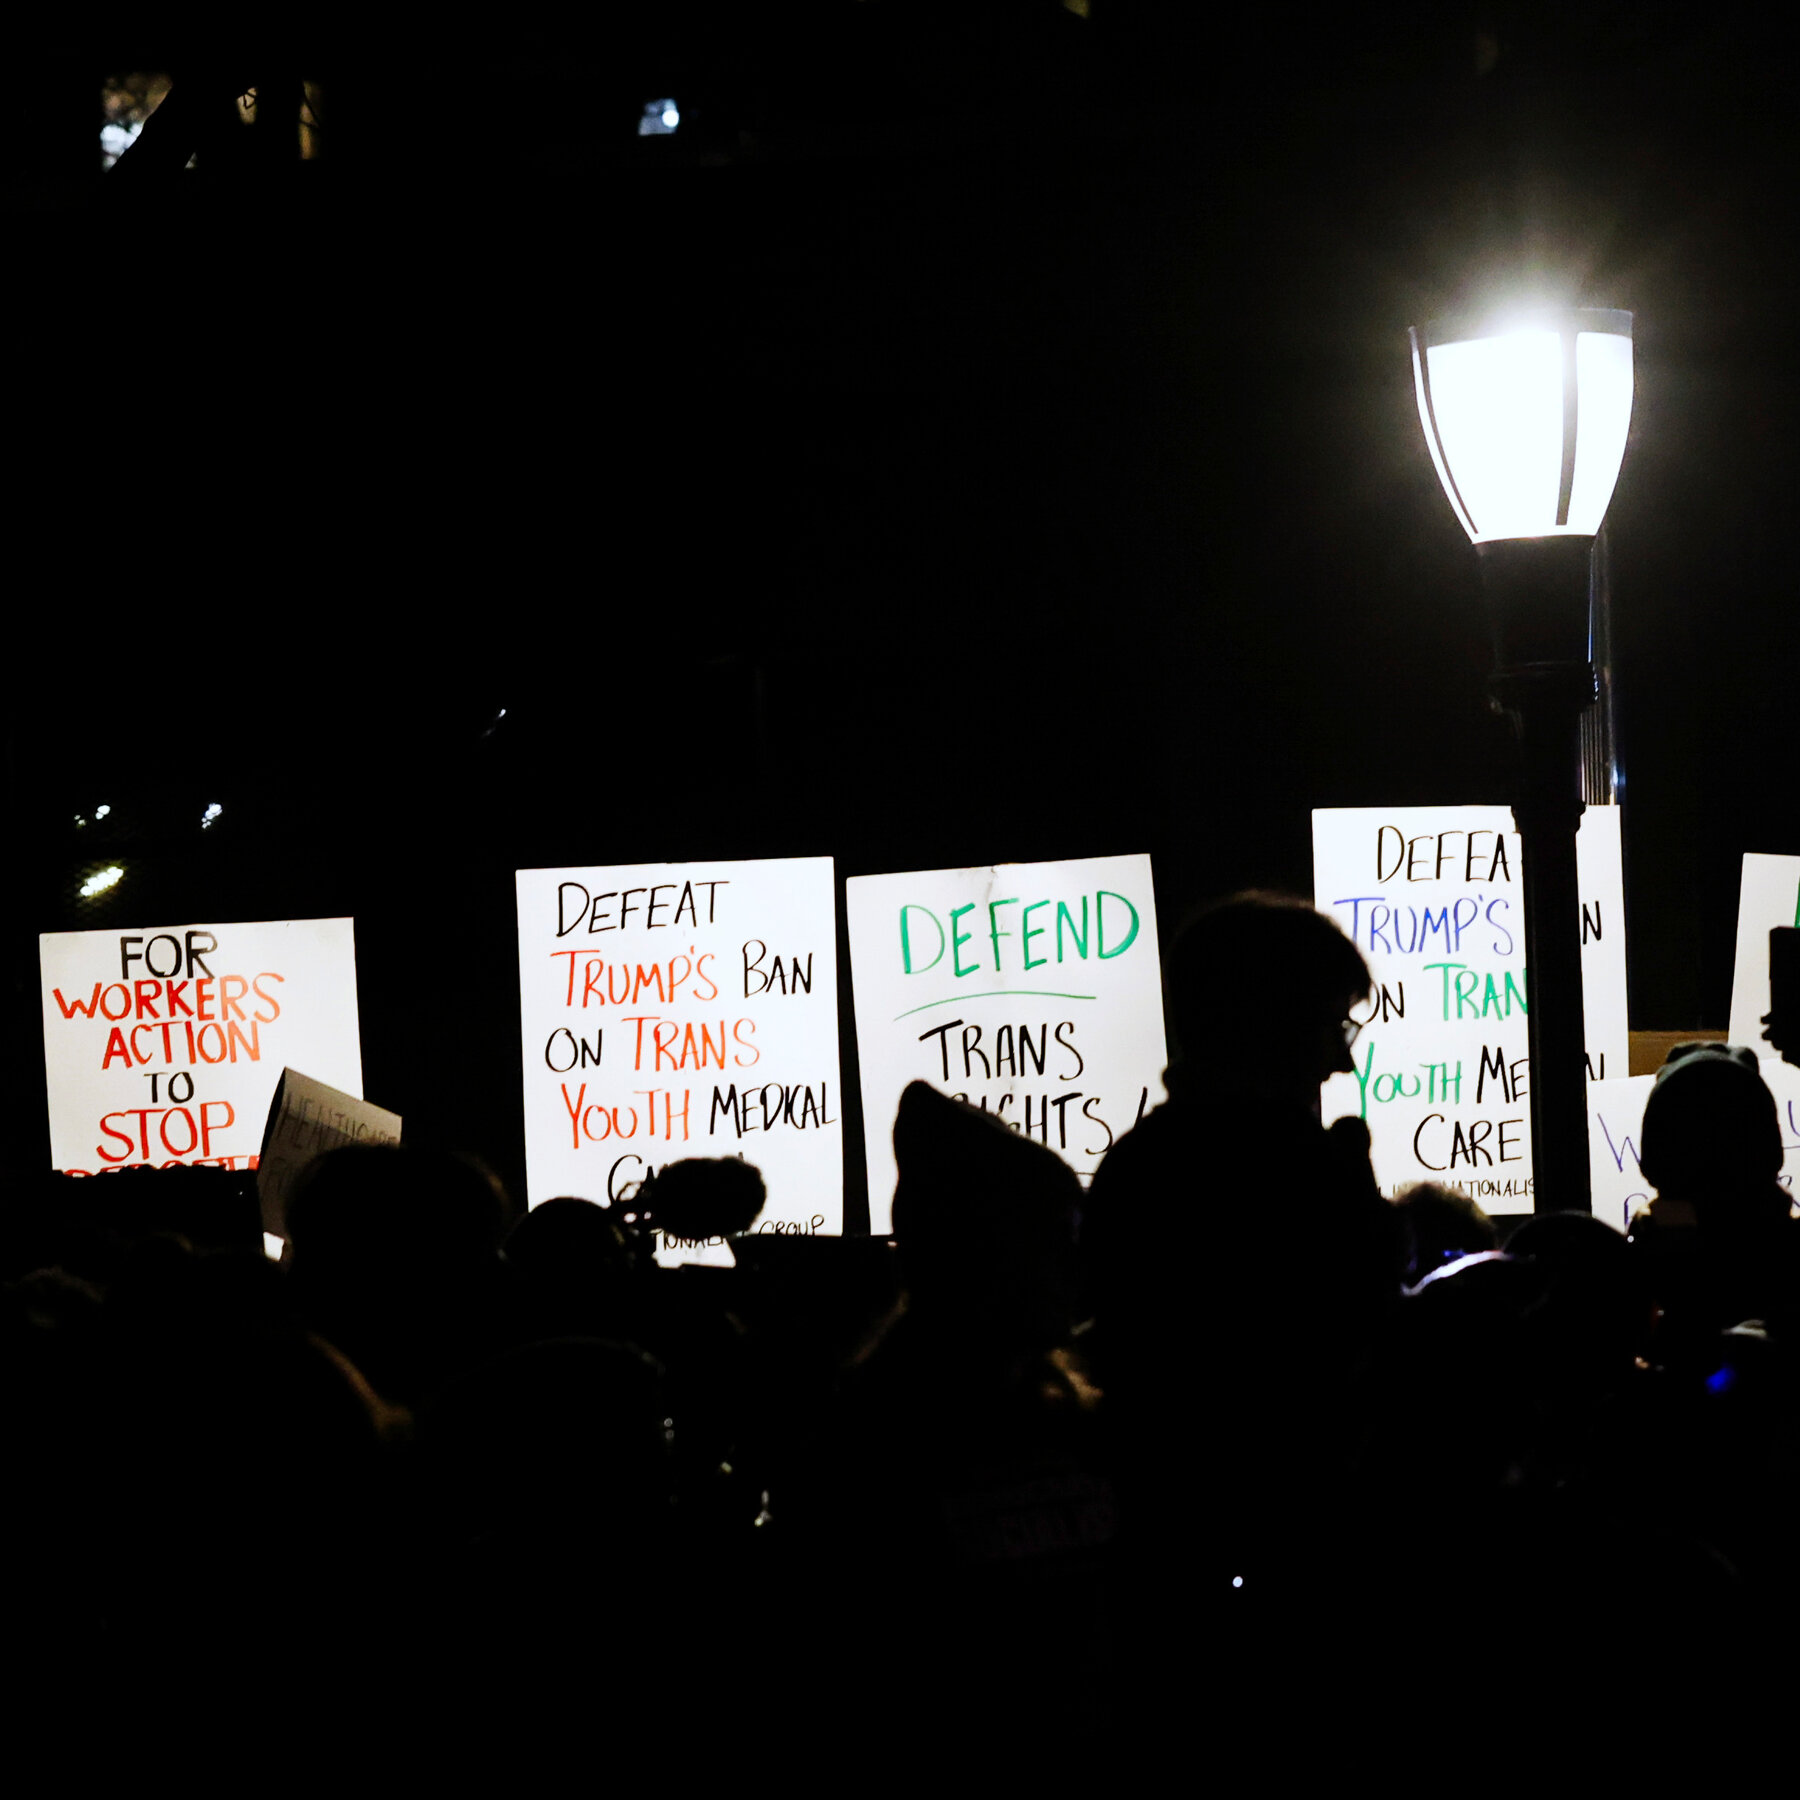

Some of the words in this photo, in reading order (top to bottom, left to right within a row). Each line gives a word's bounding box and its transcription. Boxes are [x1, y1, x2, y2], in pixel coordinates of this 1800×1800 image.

[1377, 826, 1522, 883] DEFEA
[556, 881, 729, 937] DEFEAT
[901, 891, 1139, 977] DEFEND
[1333, 895, 1513, 956] TRUMP'S
[120, 931, 218, 980] FOR
[550, 945, 718, 1008] TRUMP'S
[742, 939, 813, 998] BAN
[53, 973, 285, 1023] WORKERS
[1423, 963, 1530, 1022] TRAN
[102, 1020, 261, 1070] ACTION
[545, 1027, 602, 1072] ON
[621, 1016, 760, 1071] TRANS
[919, 1019, 1083, 1081] TRANS
[144, 1072, 195, 1104] TO
[1352, 1042, 1463, 1120] YOUTH
[96, 1101, 235, 1162] STOP
[561, 1083, 690, 1149] YOUTH
[709, 1081, 837, 1138] MEDICAL
[1414, 1113, 1524, 1171] CARE
